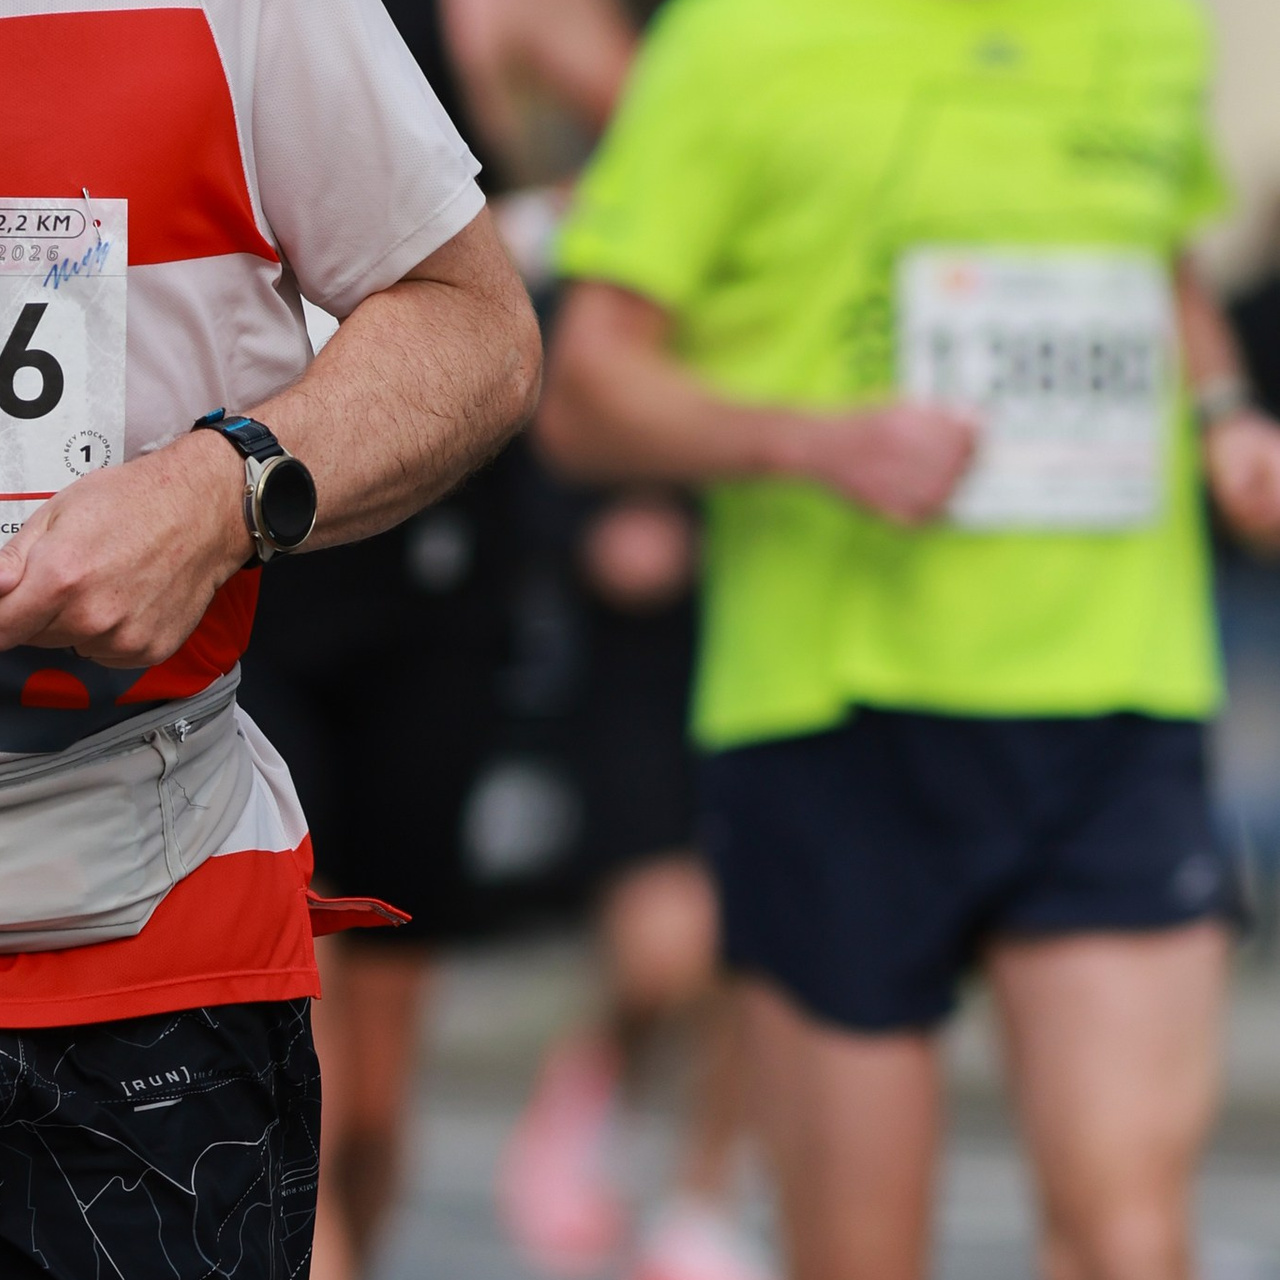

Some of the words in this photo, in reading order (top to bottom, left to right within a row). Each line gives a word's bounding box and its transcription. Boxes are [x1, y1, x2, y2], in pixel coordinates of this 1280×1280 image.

[80, 430, 111, 468] МОСКОВСКИ
[80, 445, 91, 463] 1
[121, 1066, 191, 1097] [RUN]
